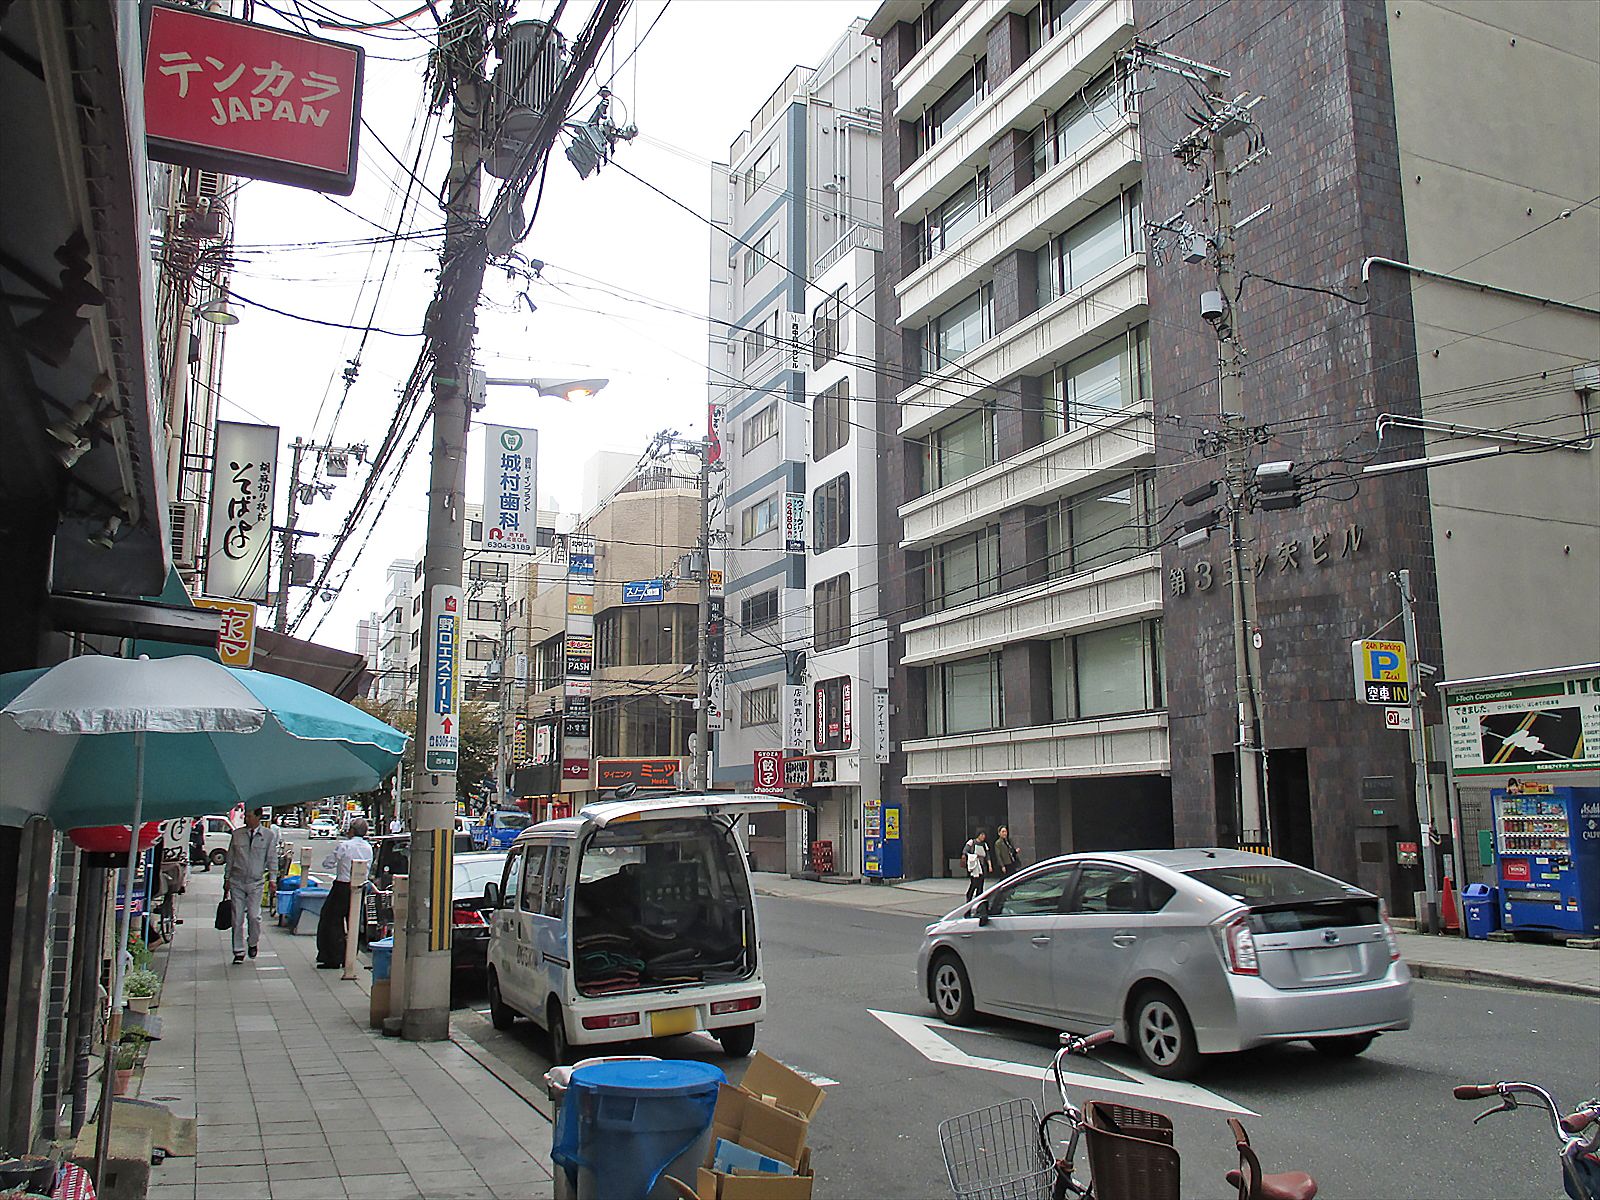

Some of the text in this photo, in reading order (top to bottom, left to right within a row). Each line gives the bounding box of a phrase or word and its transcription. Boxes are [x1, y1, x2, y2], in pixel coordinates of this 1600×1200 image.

[159, 51, 341, 103] テンカラ
[211, 96, 330, 128] JAPAN
[499, 453, 521, 531] 城村歯科
[1379, 642, 1401, 652] Parking
[436, 617, 454, 714] 野口エステート
[568, 662, 590, 671] PASH
[1370, 651, 1399, 679] P
[1367, 686, 1407, 701] 空車 IN
[1475, 691, 1512, 700] Corporation
[877, 704, 885, 751] アイキャット
[1387, 712, 1399, 724] QT
[640, 764, 676, 777] ミーツ
[762, 760, 774, 784] 餃子
